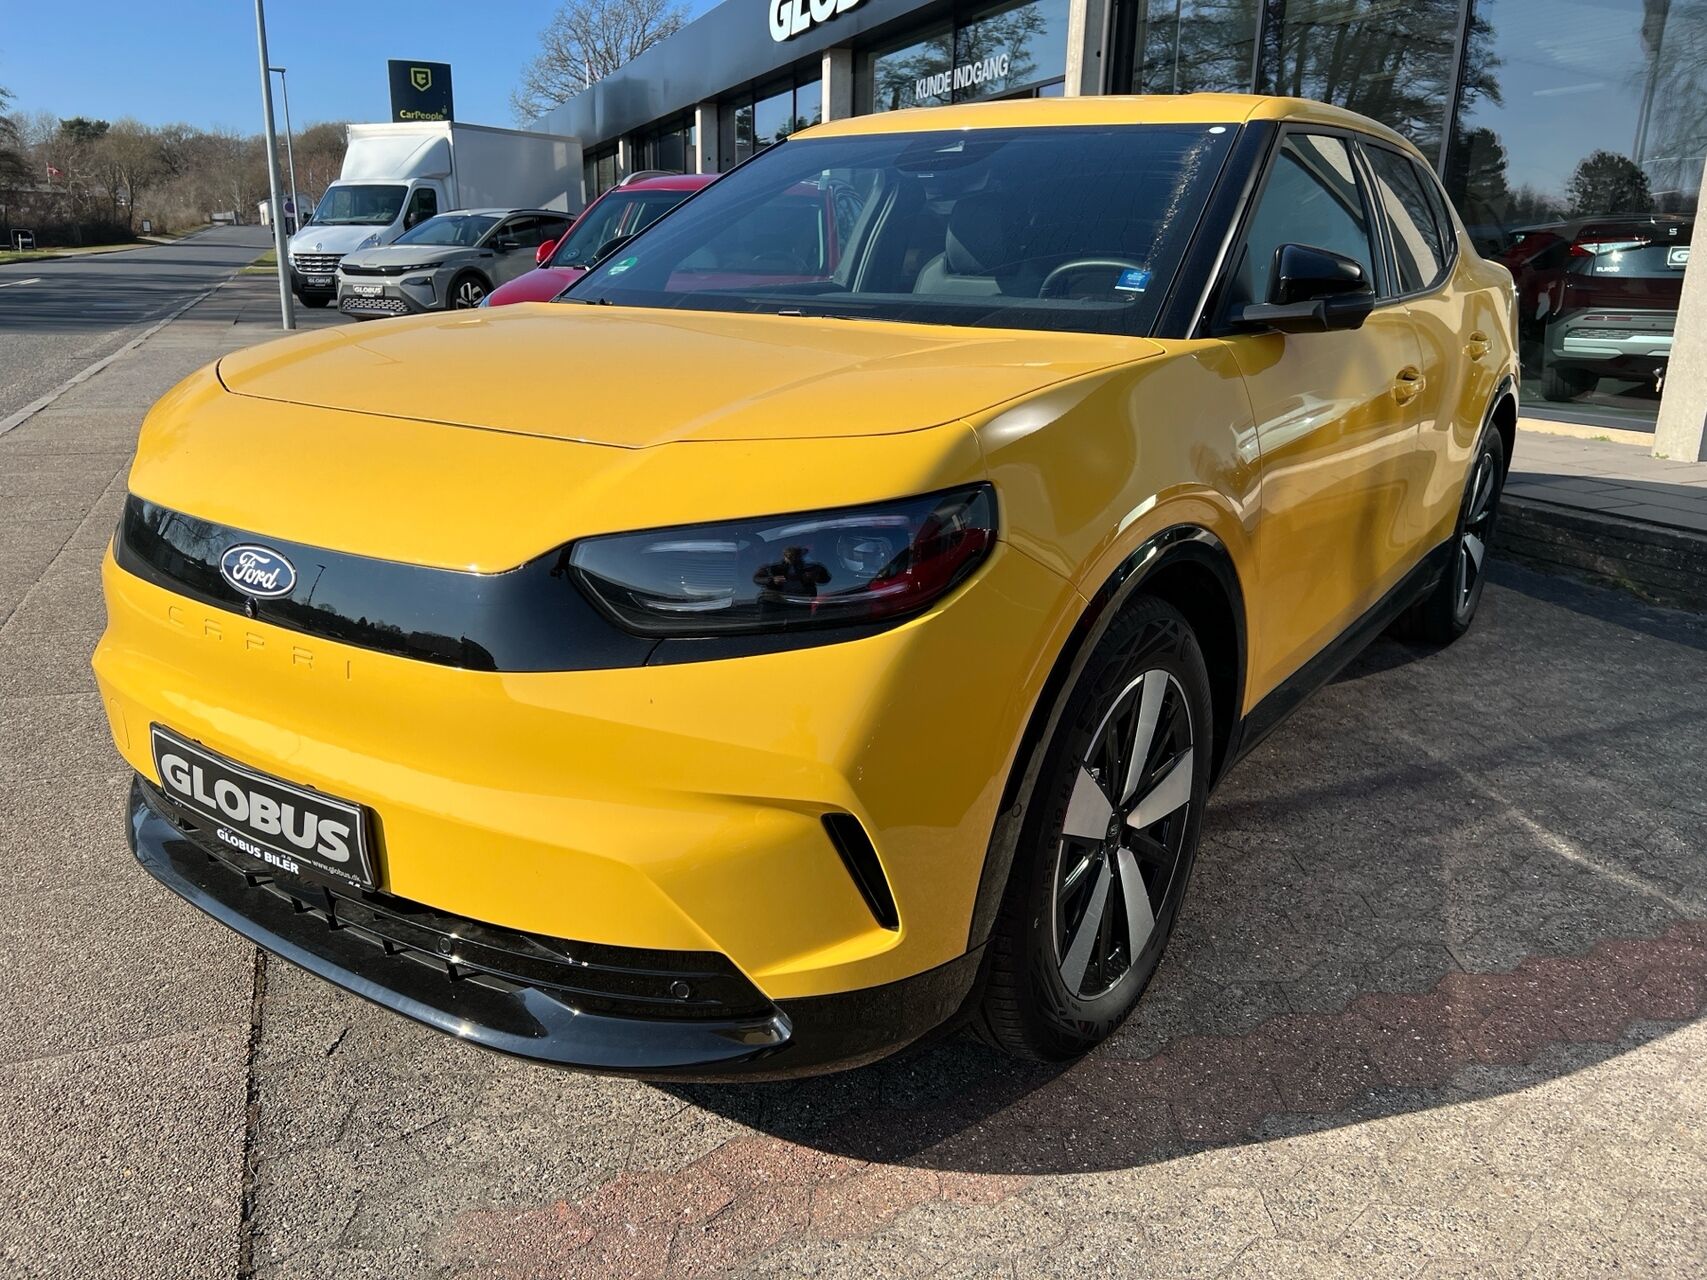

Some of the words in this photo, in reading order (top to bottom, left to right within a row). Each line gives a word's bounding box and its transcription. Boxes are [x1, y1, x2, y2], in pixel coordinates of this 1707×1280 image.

[915, 70, 951, 100] KUNDE
[953, 54, 1008, 90] INDGANG
[400, 110, 444, 121] CarPeople
[353, 286, 383, 294] GLOBUS
[232, 551, 280, 590] Ford
[168, 605, 353, 680] CAPRI
[160, 753, 351, 863] GLOBUS
[216, 828, 262, 859] GLOBUS
[264, 852, 299, 875] BILER
